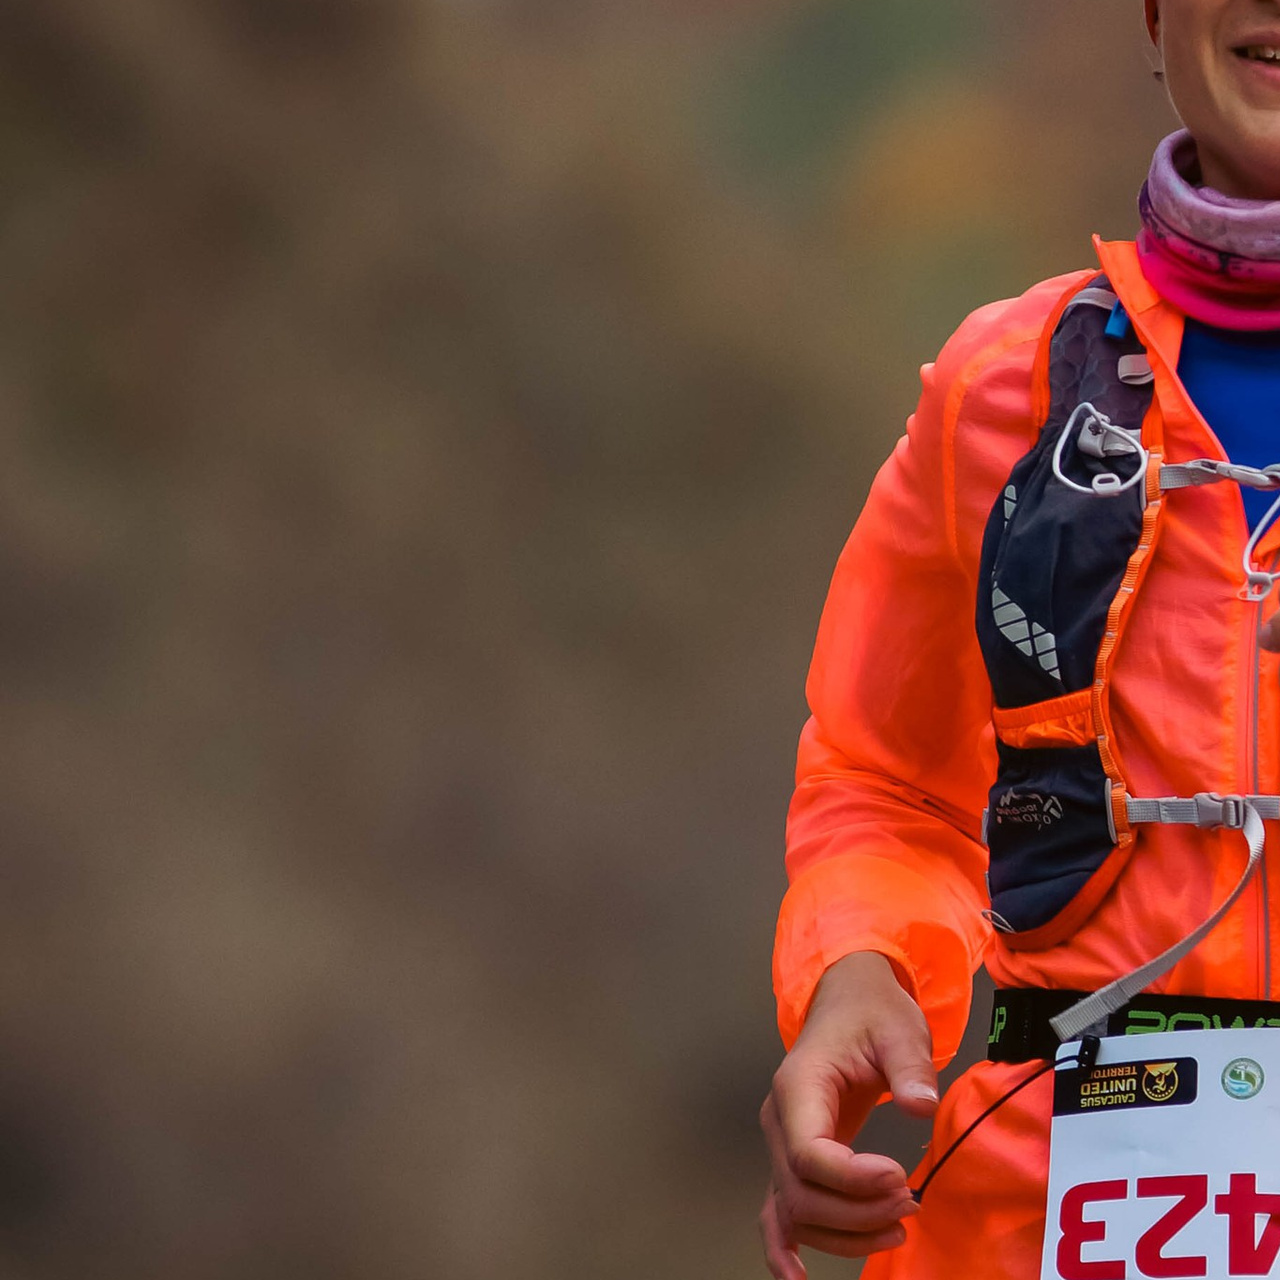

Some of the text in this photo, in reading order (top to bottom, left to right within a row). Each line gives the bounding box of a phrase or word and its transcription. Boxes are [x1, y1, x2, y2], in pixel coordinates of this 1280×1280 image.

[1091, 1065, 1138, 1079] TERRITO
[1081, 1078, 1136, 1096] UNITED
[1081, 1093, 1136, 1108] CAUCASUS
